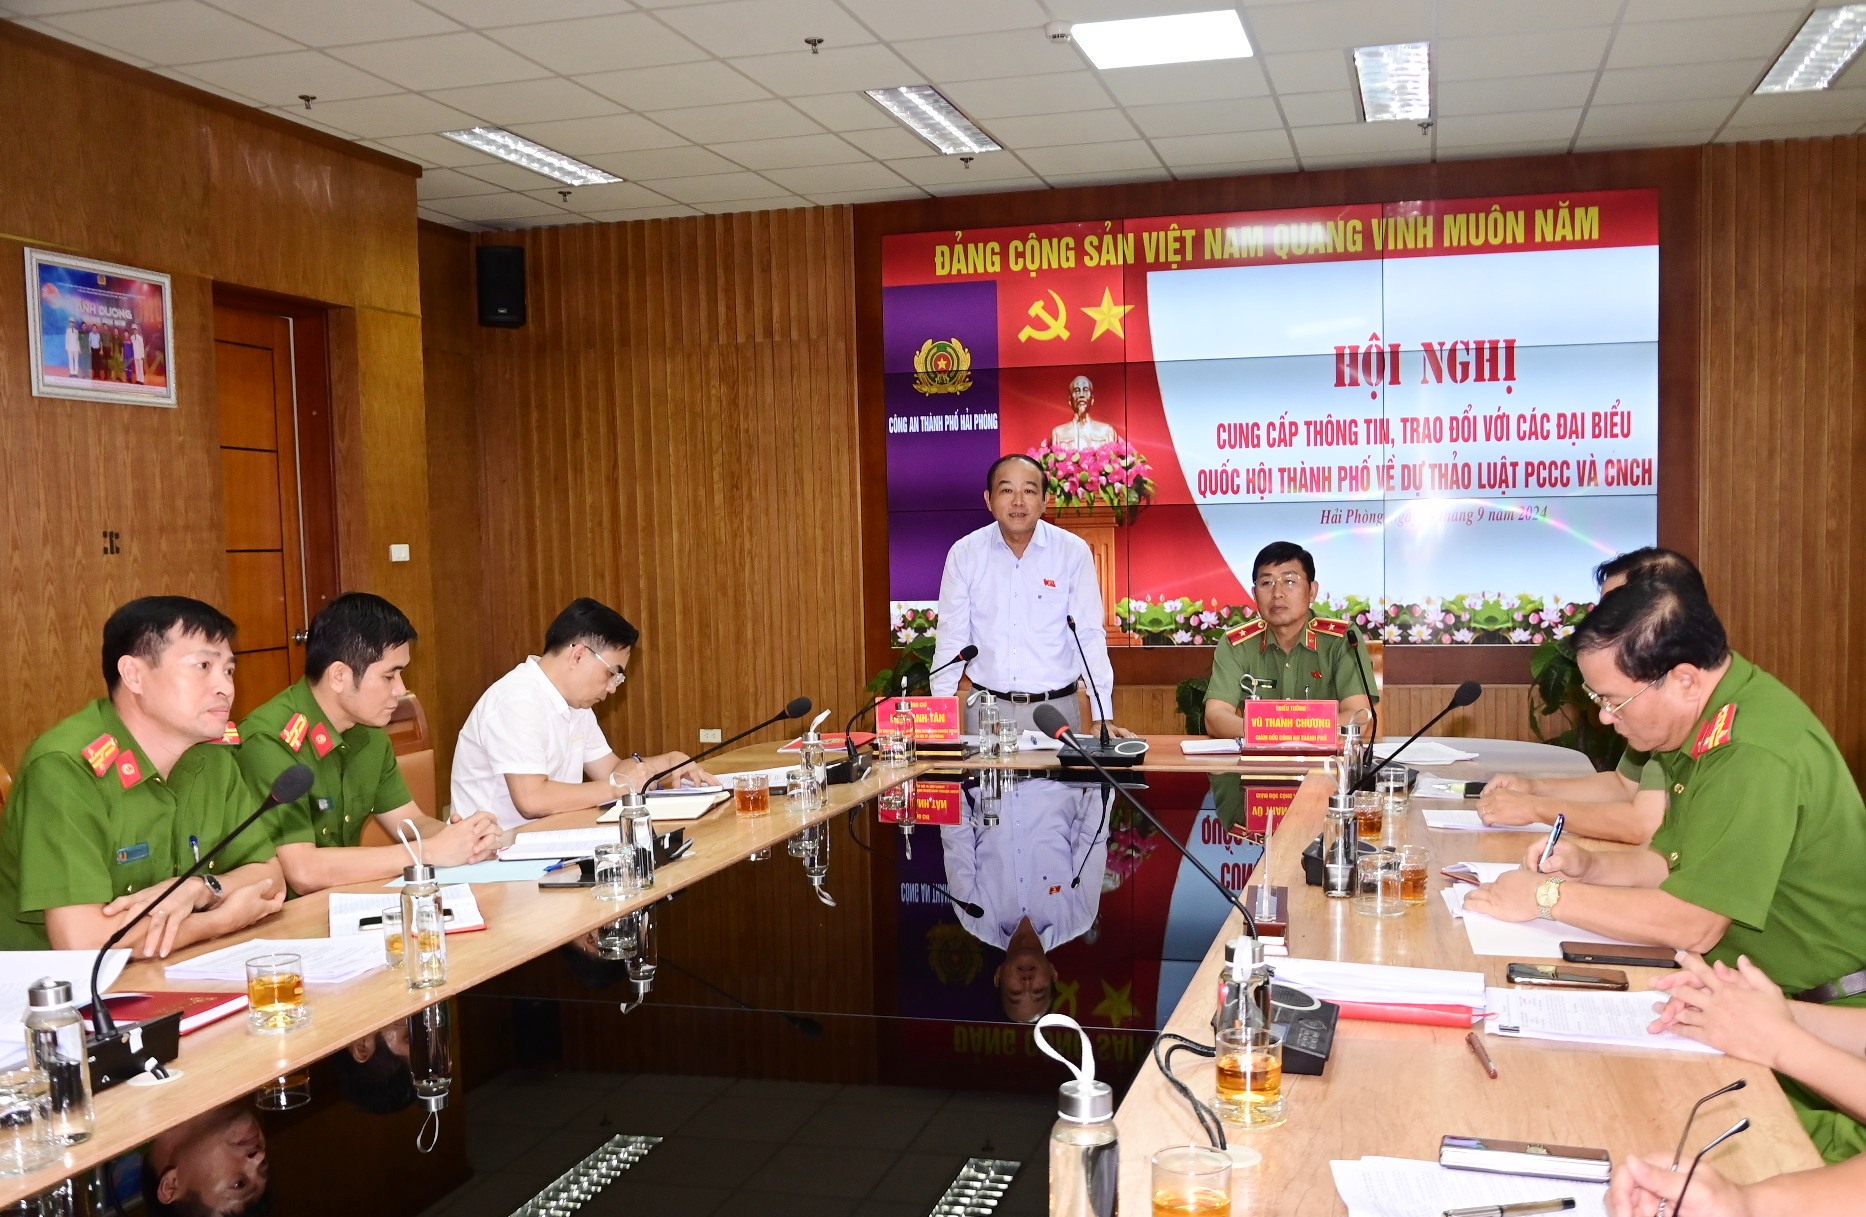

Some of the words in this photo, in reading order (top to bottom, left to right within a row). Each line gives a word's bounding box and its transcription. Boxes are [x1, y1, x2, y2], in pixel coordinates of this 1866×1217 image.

[935, 231, 1001, 276] ĐẢNG
[1008, 233, 1076, 278] CỘNG
[1083, 221, 1135, 266] SẢN
[1143, 223, 1196, 269] VIỆT
[1204, 225, 1264, 260] NAM
[1273, 219, 1363, 260] QUANG
[1371, 215, 1434, 251] VINH
[1443, 205, 1525, 248] MUÔN
[1535, 201, 1600, 242] NĂM
[1333, 332, 1402, 400] HỘI
[1420, 338, 1517, 395] NGHỊ
[888, 414, 908, 433] CÔNG
[909, 416, 920, 432] AN
[920, 412, 943, 432] THÀNH
[944, 409, 959, 431] PHỐ
[960, 408, 973, 430] HẢI
[1216, 421, 1261, 450] CUNG
[1266, 411, 1299, 448] CẤP
[1304, 414, 1359, 447] THÔNG
[1364, 417, 1395, 449] TIN,
[1400, 416, 1444, 445] TRAO
[1448, 403, 1478, 443] ĐỔI
[1483, 406, 1511, 442] VỚI
[1516, 407, 1551, 441] CÁC
[1556, 412, 1585, 446] ĐẠI
[1591, 399, 1632, 440] BIỂU
[1197, 459, 1241, 499] QUỐC
[1245, 462, 1273, 500] HỘI
[1278, 460, 1332, 494] THÀNH
[1337, 455, 1371, 493] PHỐ
[1376, 454, 1396, 492] VỀ
[1401, 460, 1425, 497] DỰ
[1428, 451, 1472, 490] THẢO
[1477, 456, 1519, 495] LUẬT
[1524, 460, 1571, 488] PCCC
[1576, 453, 1599, 487] VÀ
[1604, 458, 1653, 487] CNCH
[1320, 508, 1343, 524] Hải
[1476, 507, 1485, 522] 9
[1517, 504, 1549, 522] 2024
[1265, 717, 1293, 728] THANH
